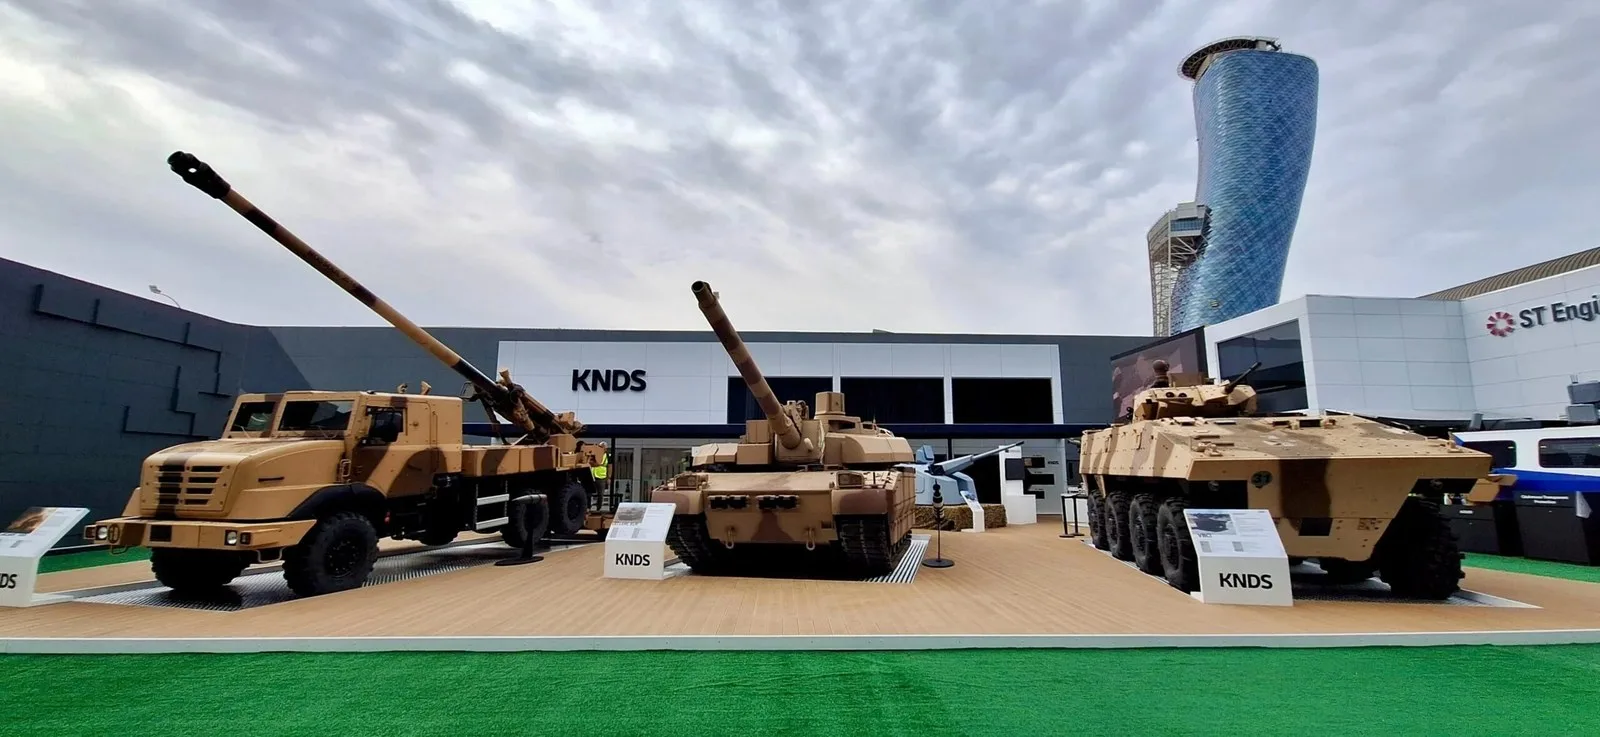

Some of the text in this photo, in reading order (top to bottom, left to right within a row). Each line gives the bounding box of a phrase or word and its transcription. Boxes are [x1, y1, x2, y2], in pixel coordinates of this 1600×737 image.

[1519, 306, 1546, 328] ST
[572, 369, 647, 393] KNDS
[616, 553, 651, 567] KNDS
[0, 573, 17, 589] DS
[1219, 572, 1273, 590] KNDS
